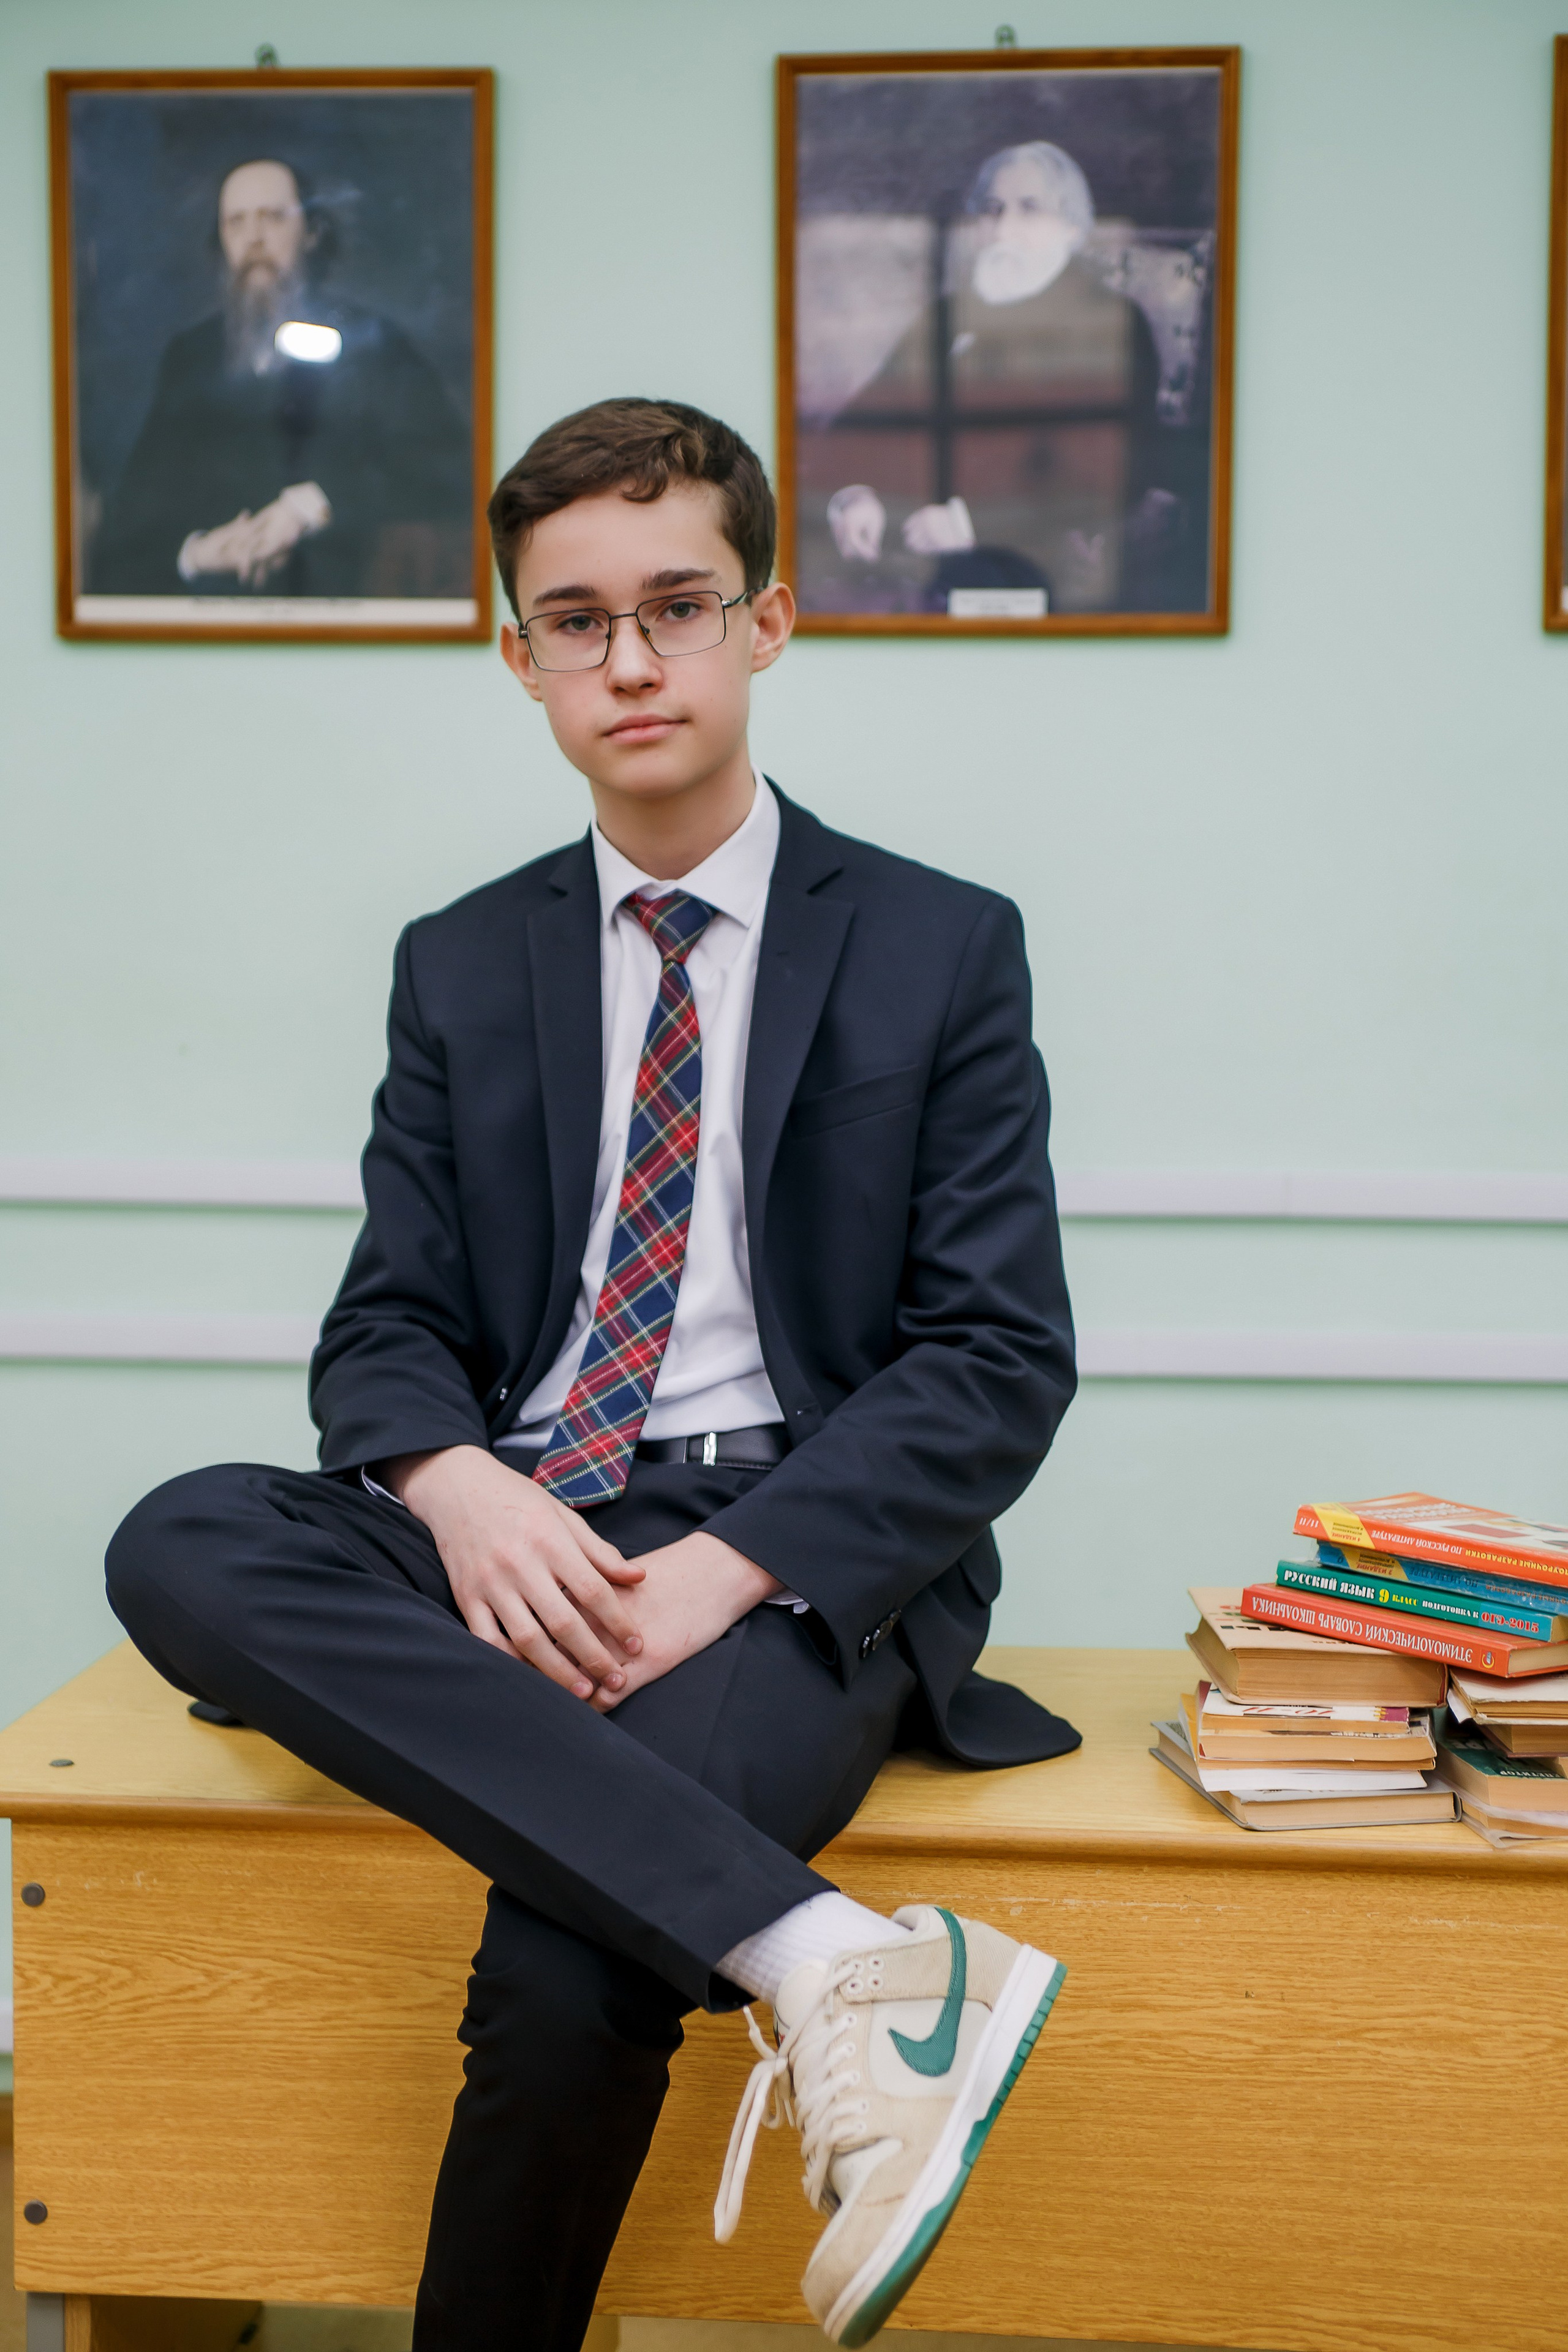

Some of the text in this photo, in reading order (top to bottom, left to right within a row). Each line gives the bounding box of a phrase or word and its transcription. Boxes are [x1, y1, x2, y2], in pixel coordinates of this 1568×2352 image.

[1371, 1529, 1414, 1546] ЛИТЕРАТУРЕ
[1415, 1538, 1449, 1553] РУССКОЙ
[1451, 1545, 1462, 1555] ПО
[1466, 1549, 1517, 1566] РАЗРАБОТКИ
[1284, 1570, 1337, 1591] РУССКИЙ
[1340, 1582, 1375, 1599] ЯЗЫК
[1379, 1589, 1389, 1604] 9
[1392, 1594, 1419, 1606] КЛАСС
[1422, 1600, 1471, 1616] ПОДГОТОВКА
[1481, 1611, 1539, 1634] ОГЭ-2015
[1252, 1596, 1473, 1663] ЭТИМОЛОГИЧЕСКИЙ СЛОВАРЬ ШКОЛЬНИКА
